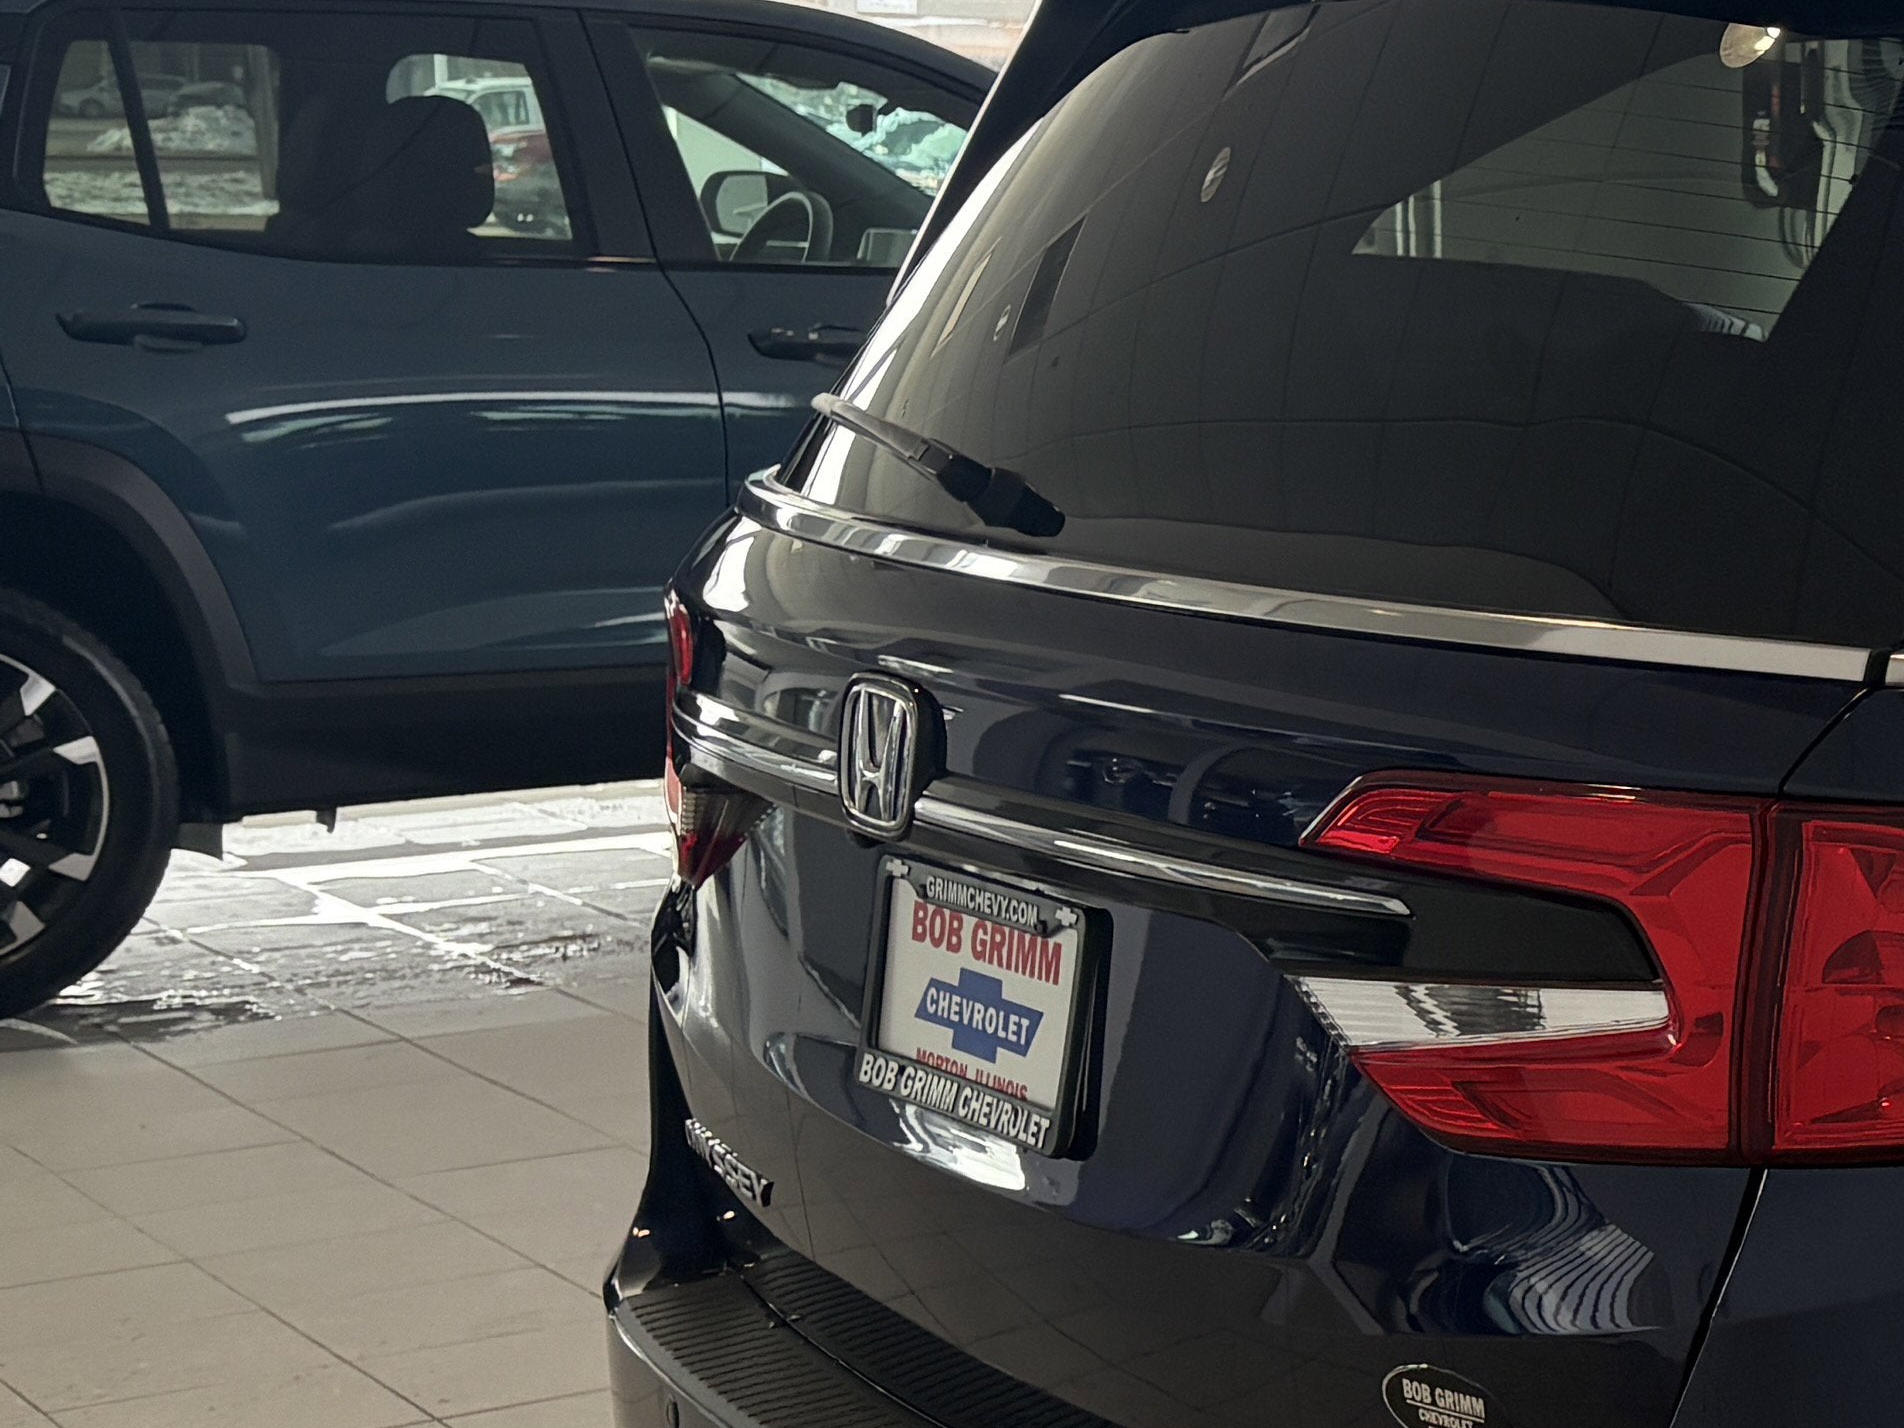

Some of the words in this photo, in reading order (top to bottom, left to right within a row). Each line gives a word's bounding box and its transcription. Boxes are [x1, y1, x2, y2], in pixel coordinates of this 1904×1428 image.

[926, 876, 1038, 926] GRIMMCHEVY.COM
[911, 900, 964, 954] BOB
[970, 918, 1063, 986] GRIMM
[926, 987, 1030, 1045] CHEVROLET
[859, 1053, 900, 1091] BOB
[900, 1066, 959, 1112] GRIMM
[958, 1087, 1050, 1149] CHEVROLET
[1402, 1378, 1432, 1404] BOB
[1435, 1387, 1485, 1419] GRIMM
